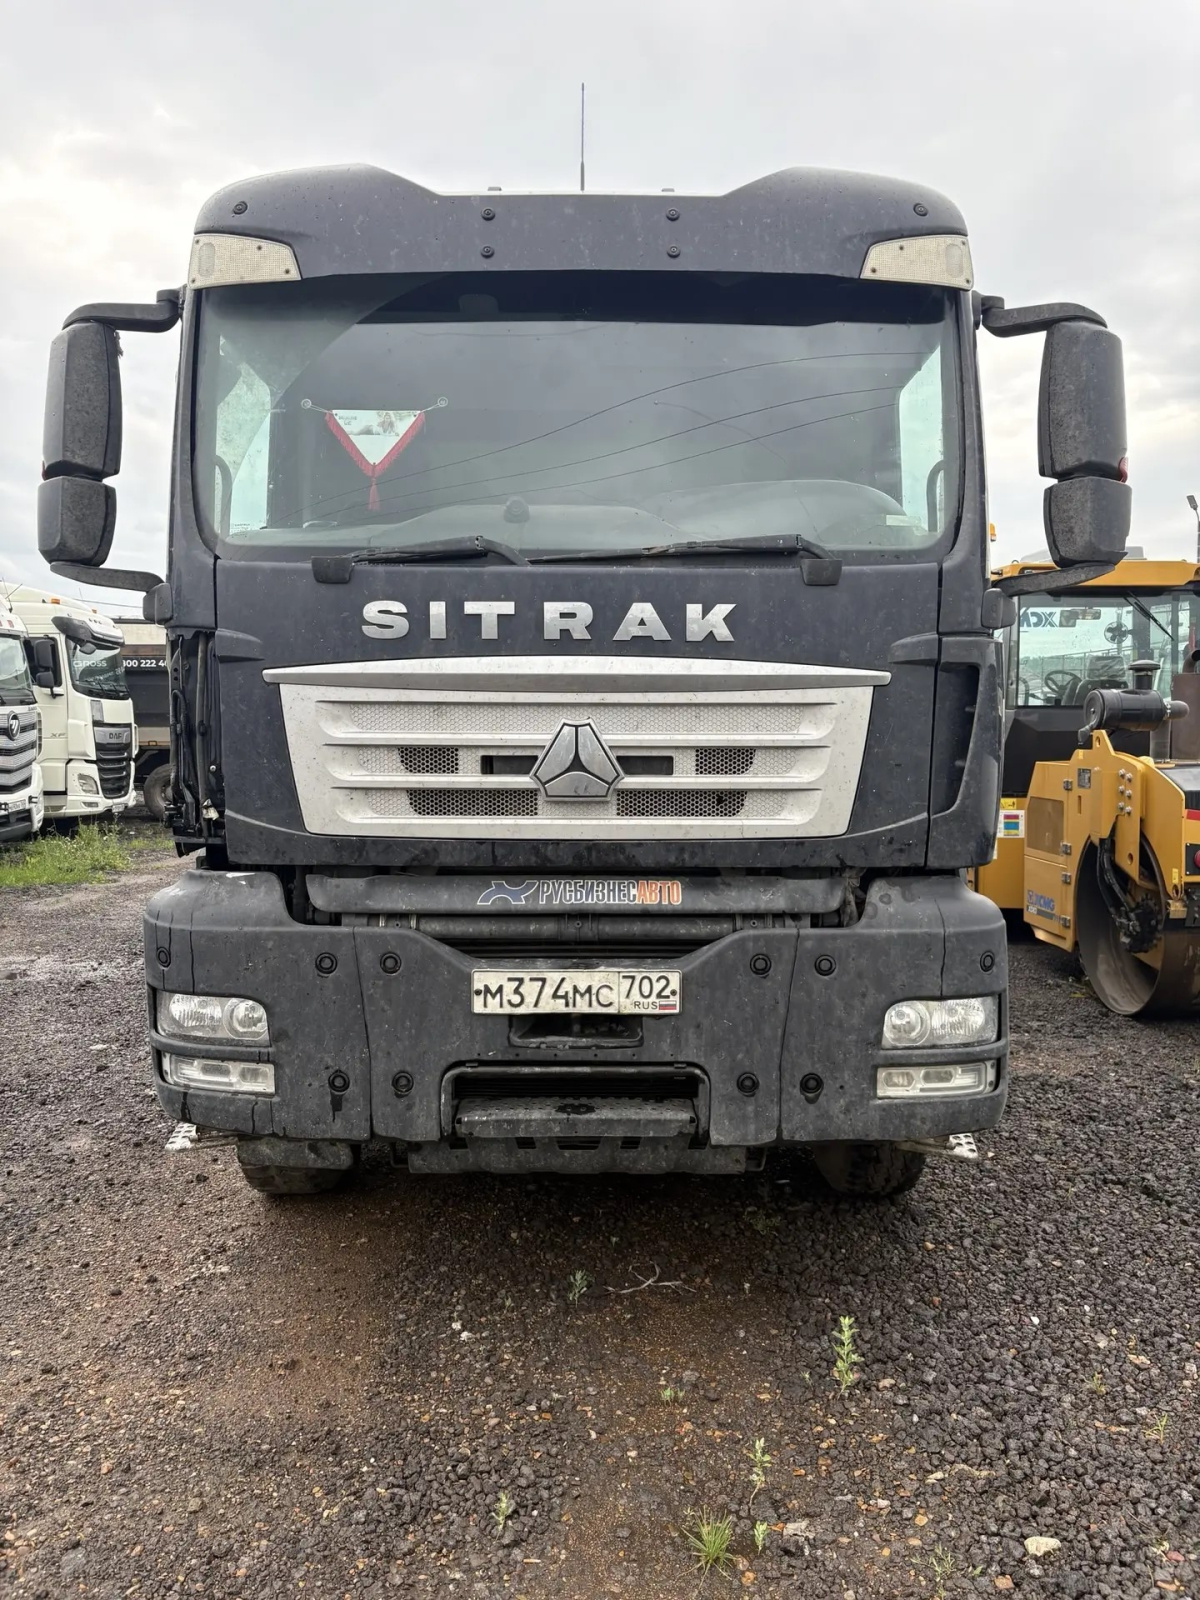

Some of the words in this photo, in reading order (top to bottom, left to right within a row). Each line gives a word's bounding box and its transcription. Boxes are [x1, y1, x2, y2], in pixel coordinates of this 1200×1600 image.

[361, 600, 737, 642] SITRAK
[140, 659, 157, 668] 222
[108, 732, 123, 740] DAF
[539, 880, 682, 905] РУСБИЗНЕСАВТО
[622, 975, 671, 999] 702
[633, 1000, 658, 1010] RUS
